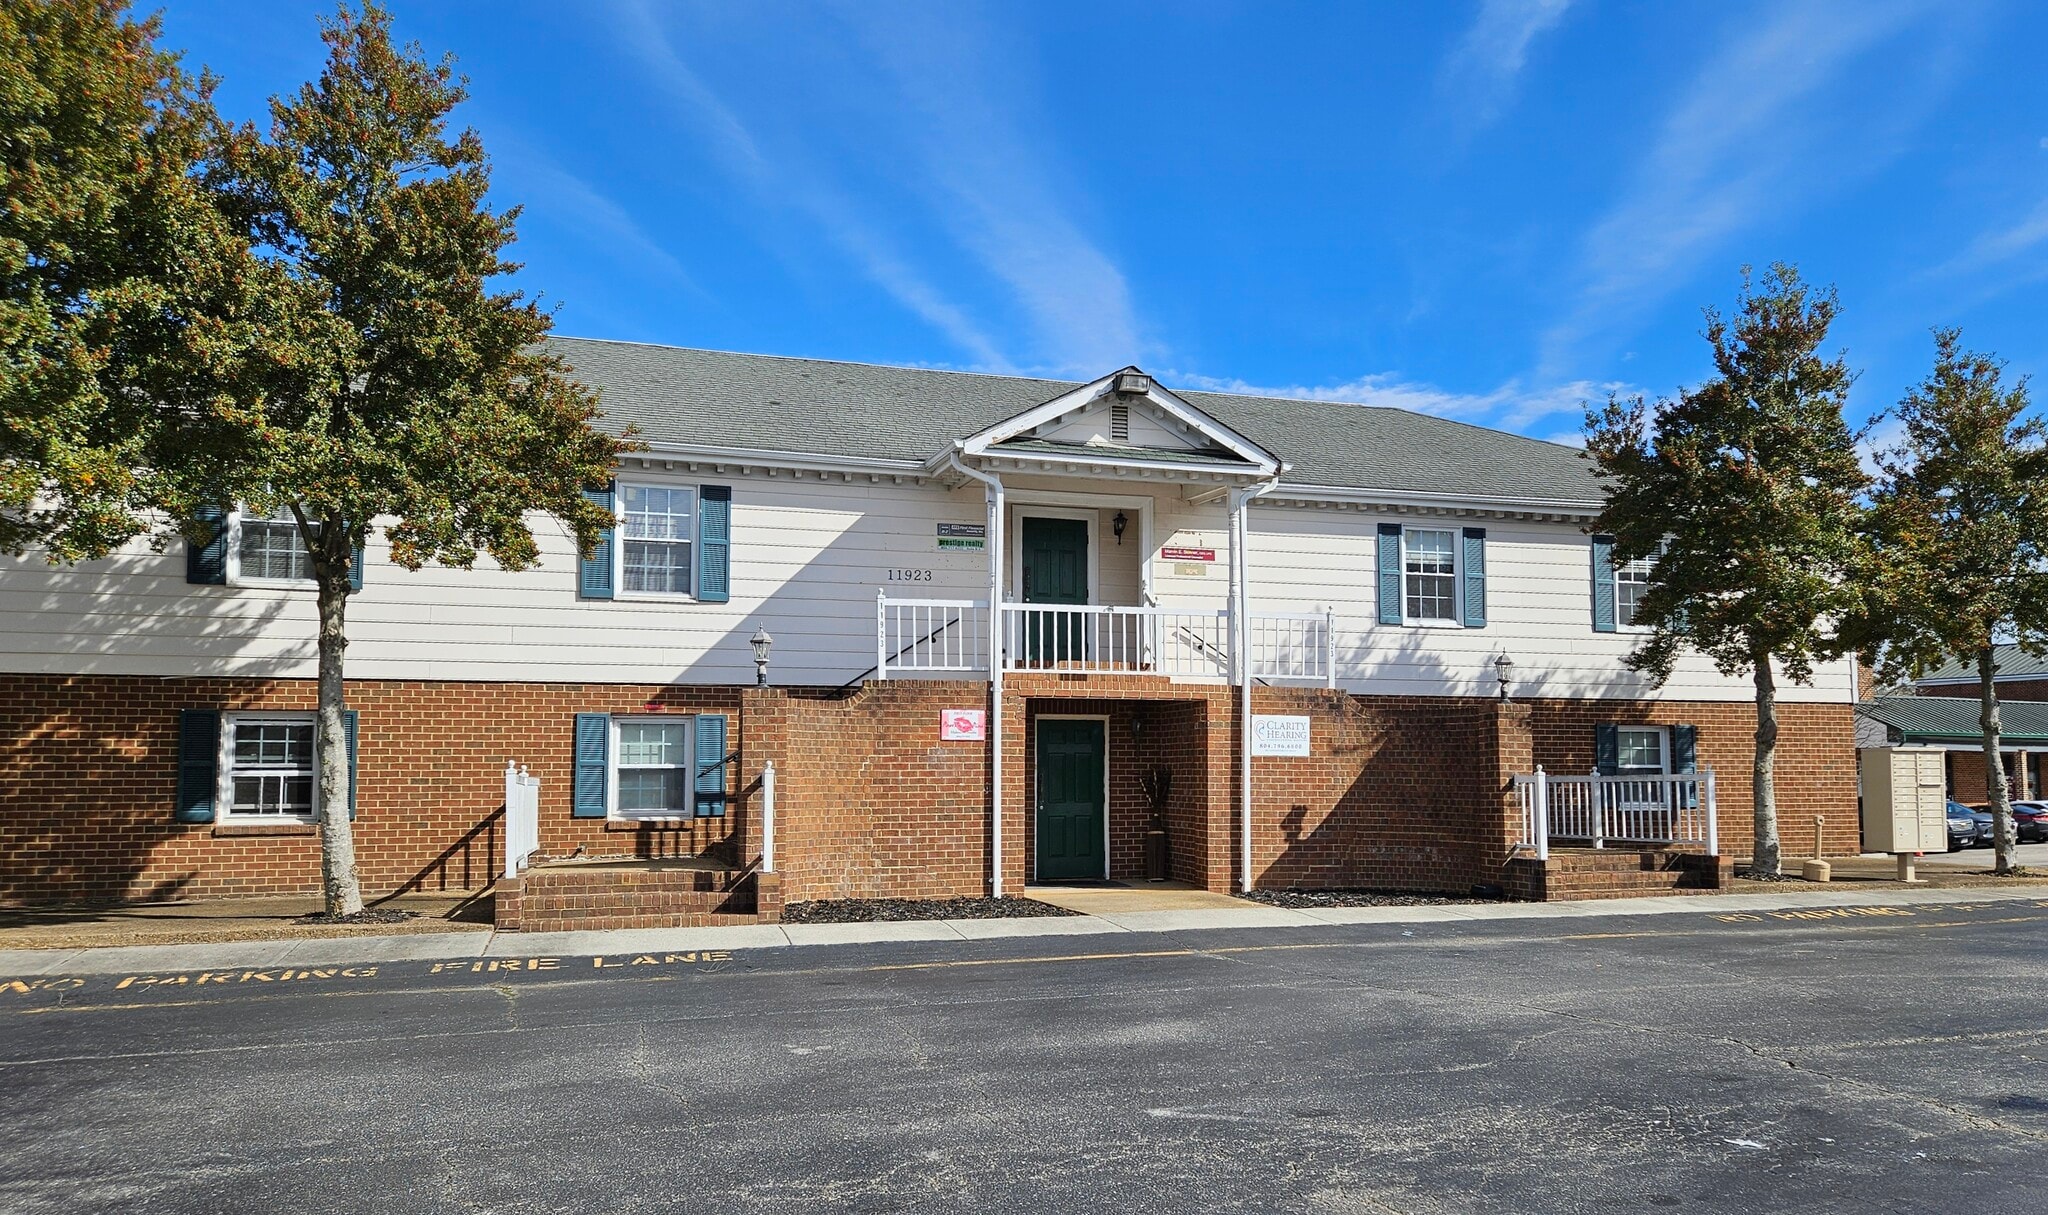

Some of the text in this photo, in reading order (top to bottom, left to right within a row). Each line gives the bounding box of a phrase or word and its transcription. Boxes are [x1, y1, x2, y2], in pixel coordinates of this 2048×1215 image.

[965, 540, 984, 548] realty
[888, 569, 932, 581] 11923
[1266, 720, 1307, 731] CLARITY
[1266, 730, 1307, 739] HEARING
[1765, 906, 1916, 920] PARKING
[0, 951, 733, 994] NO PARKING FIRE LANE
